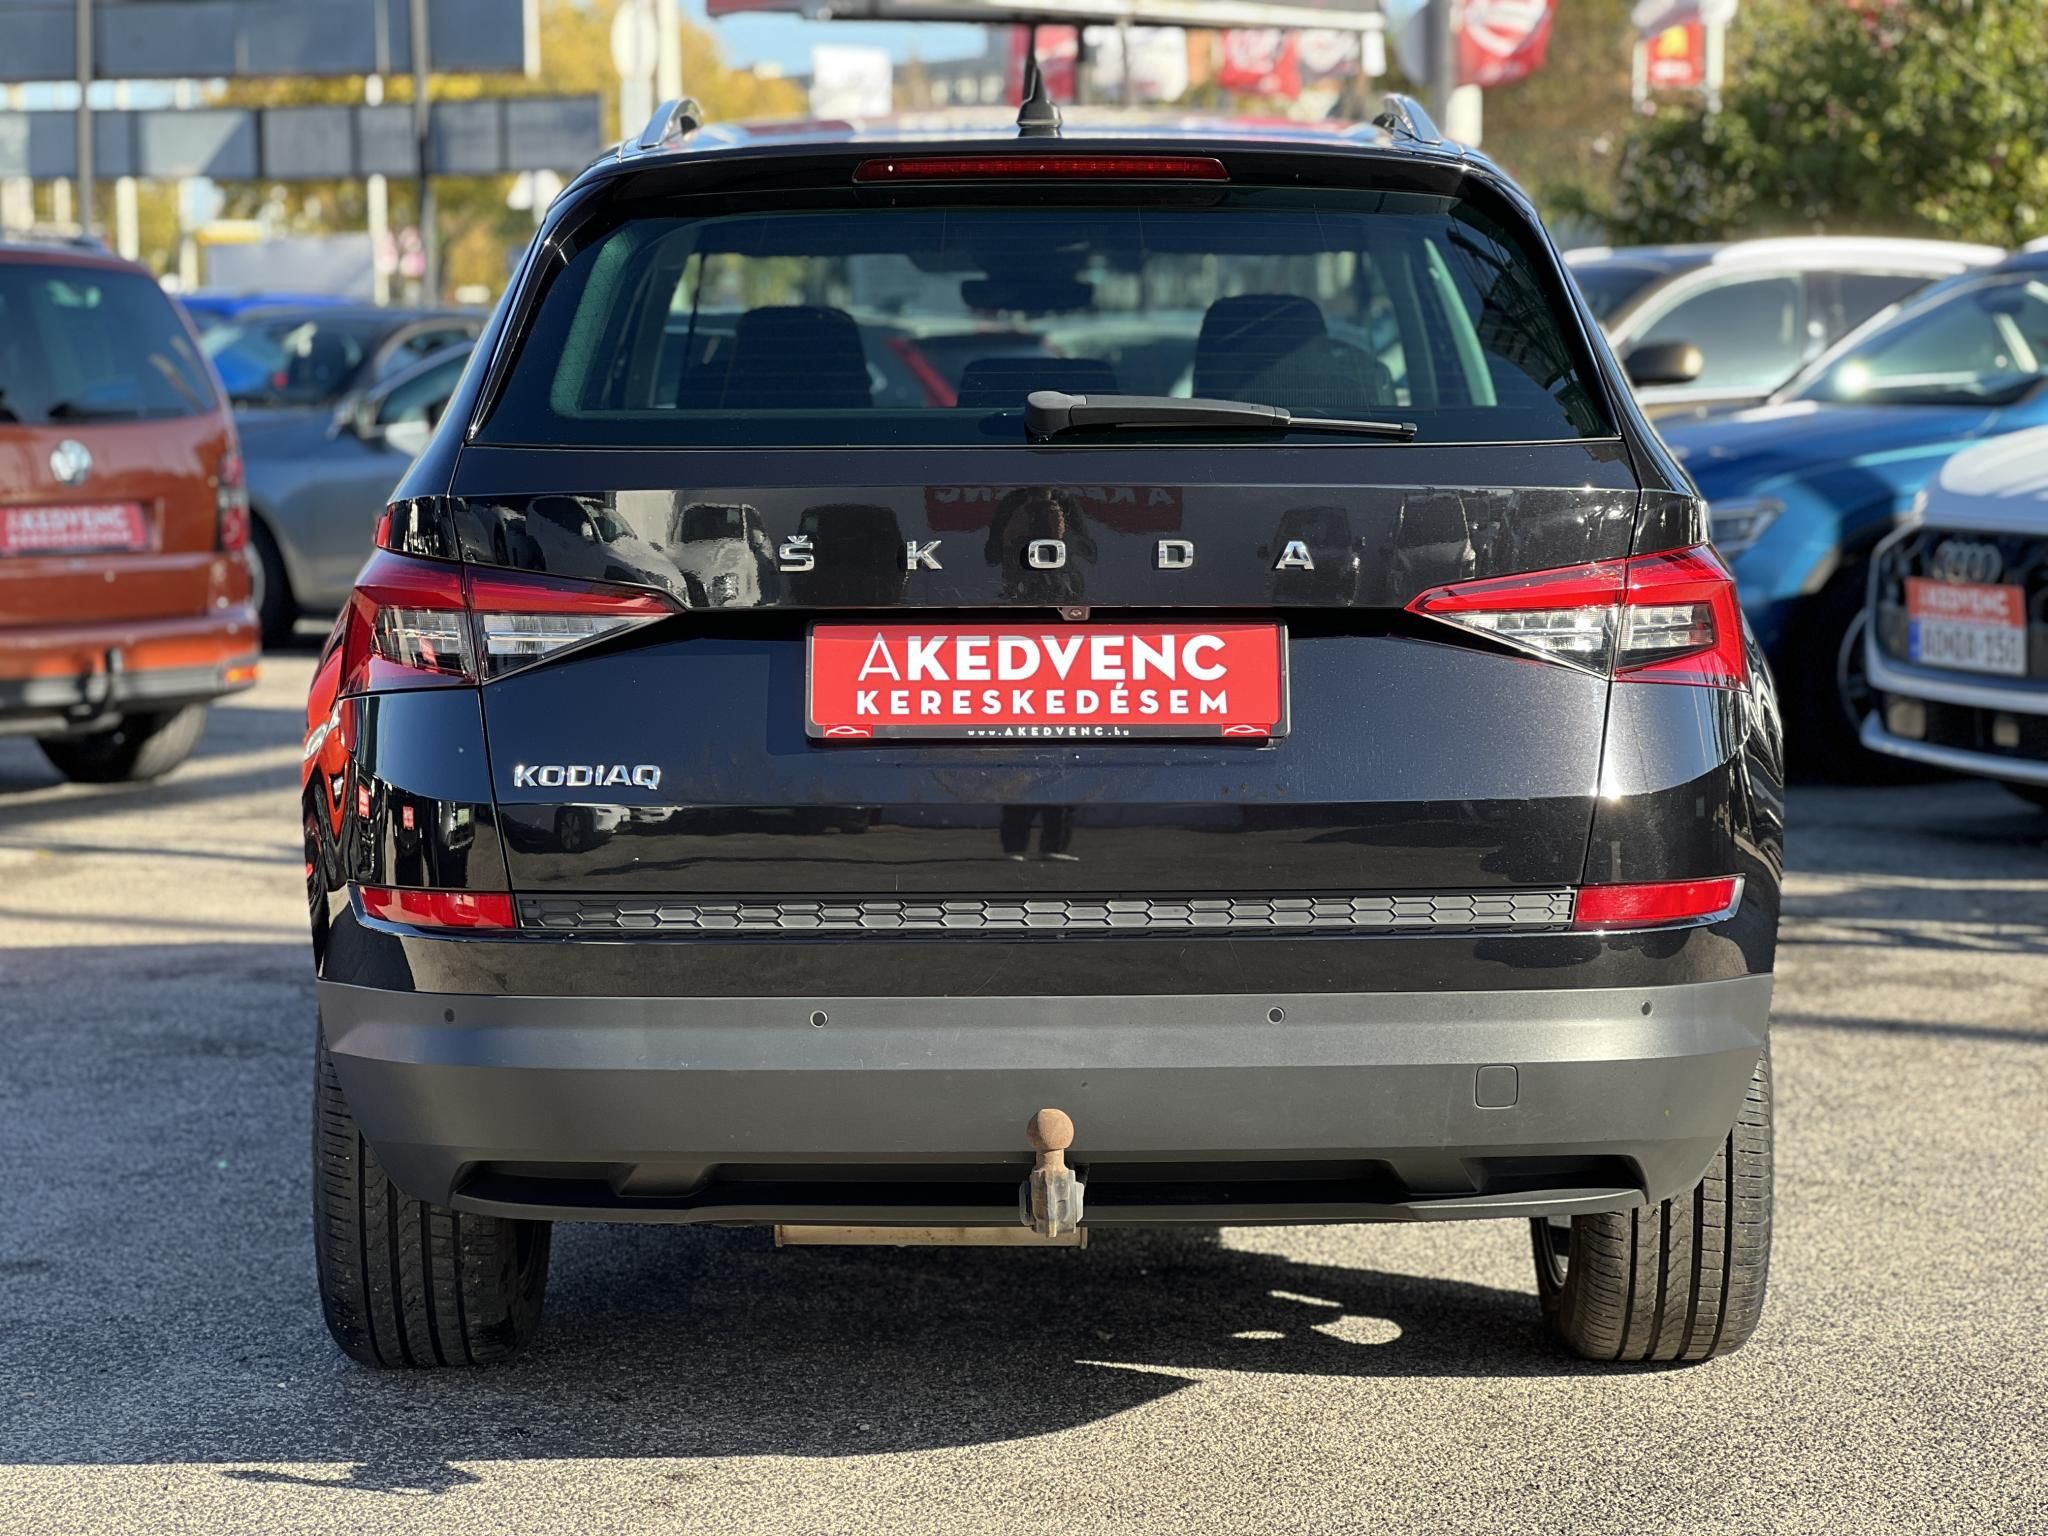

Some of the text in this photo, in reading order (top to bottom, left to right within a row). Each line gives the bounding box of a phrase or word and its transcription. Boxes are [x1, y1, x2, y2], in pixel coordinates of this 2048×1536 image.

[779, 535, 1315, 571] ŠKODA
[856, 682, 1228, 715] KERESKEDÉSEM
[967, 726, 1130, 737] www.AKEDVENC.hu
[513, 764, 661, 790] KODIAQ
